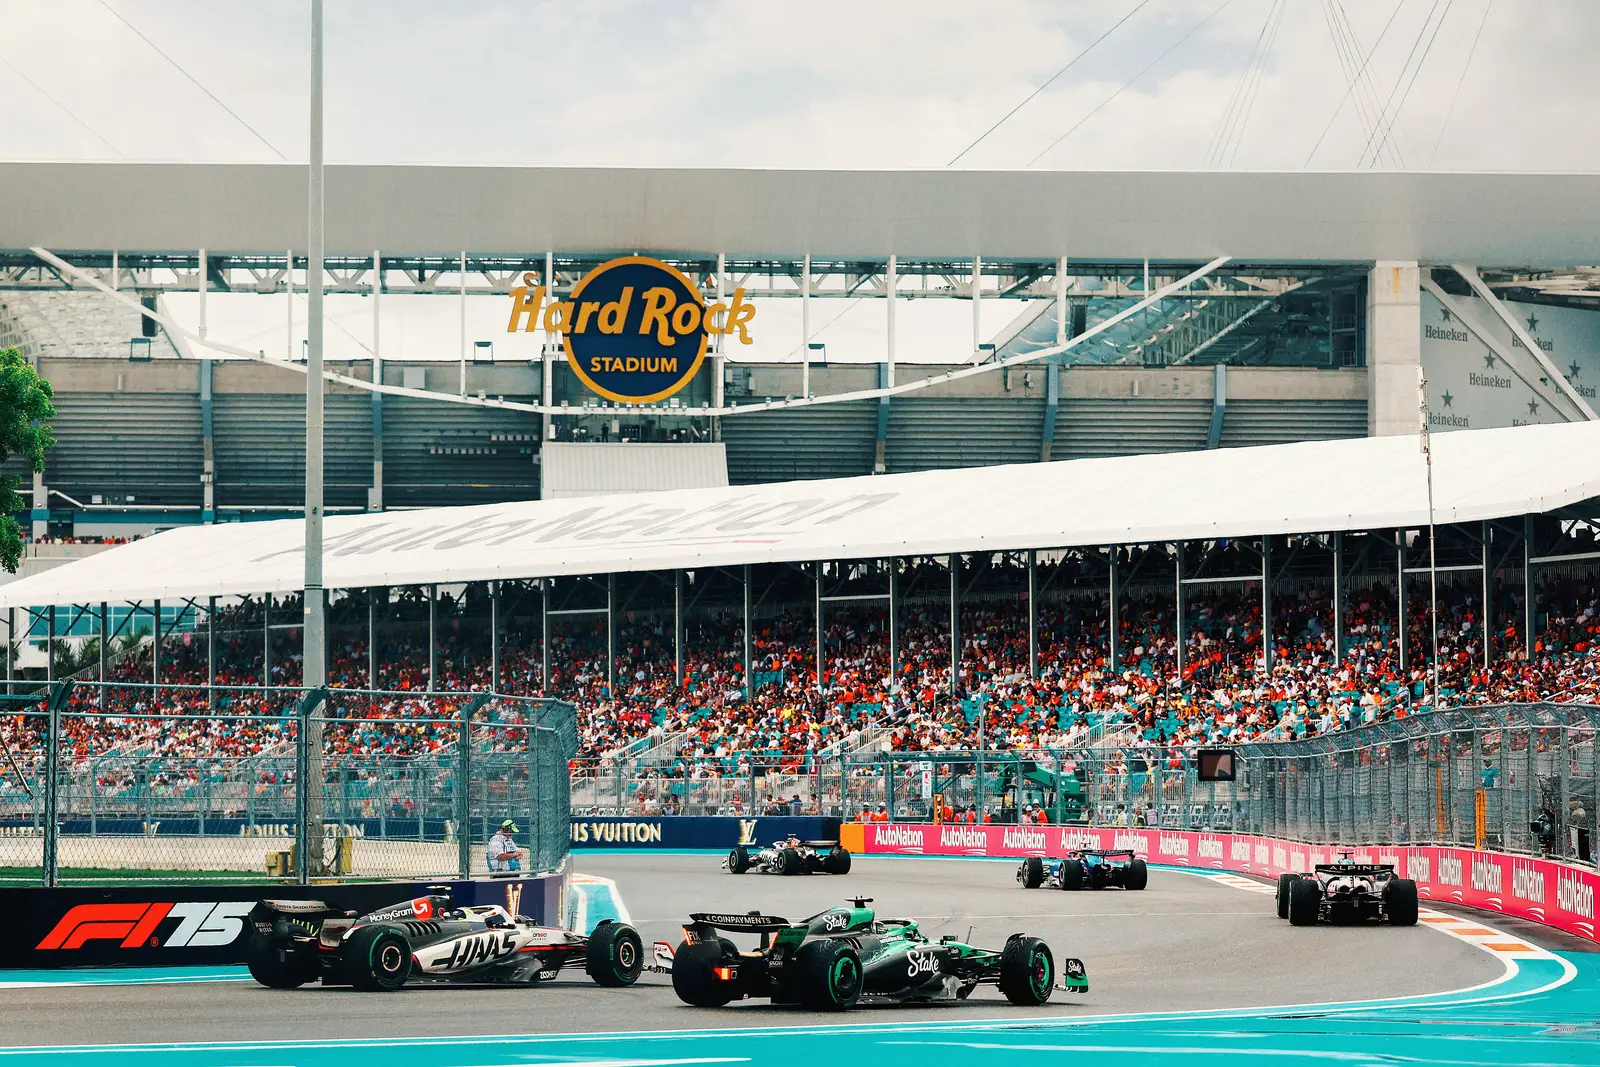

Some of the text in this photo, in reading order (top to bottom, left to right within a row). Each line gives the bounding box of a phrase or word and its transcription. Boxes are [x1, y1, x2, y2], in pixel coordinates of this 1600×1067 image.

[507, 286, 756, 346] Hard Rock
[1425, 325, 1468, 342] Heineken
[1512, 335, 1553, 351] Heken
[590, 357, 677, 373] STADIUM
[1469, 372, 1512, 389] Heineken
[590, 822, 661, 842] VUITTON
[875, 826, 924, 846] AutoNation
[940, 827, 987, 847] AutoNation
[1003, 828, 1046, 849] AutoNation
[1471, 852, 1502, 894] AutoNation
[1512, 858, 1544, 904] AutoNation
[1556, 866, 1594, 920] AutoNation
[163, 902, 258, 947] 75
[369, 907, 413, 922] MoneyGram
[711, 915, 771, 924] COINPAYMENTS
[822, 914, 847, 931] Stake
[431, 931, 520, 970] HAAS
[906, 950, 939, 977] Stake
[1068, 960, 1082, 974] Stake
